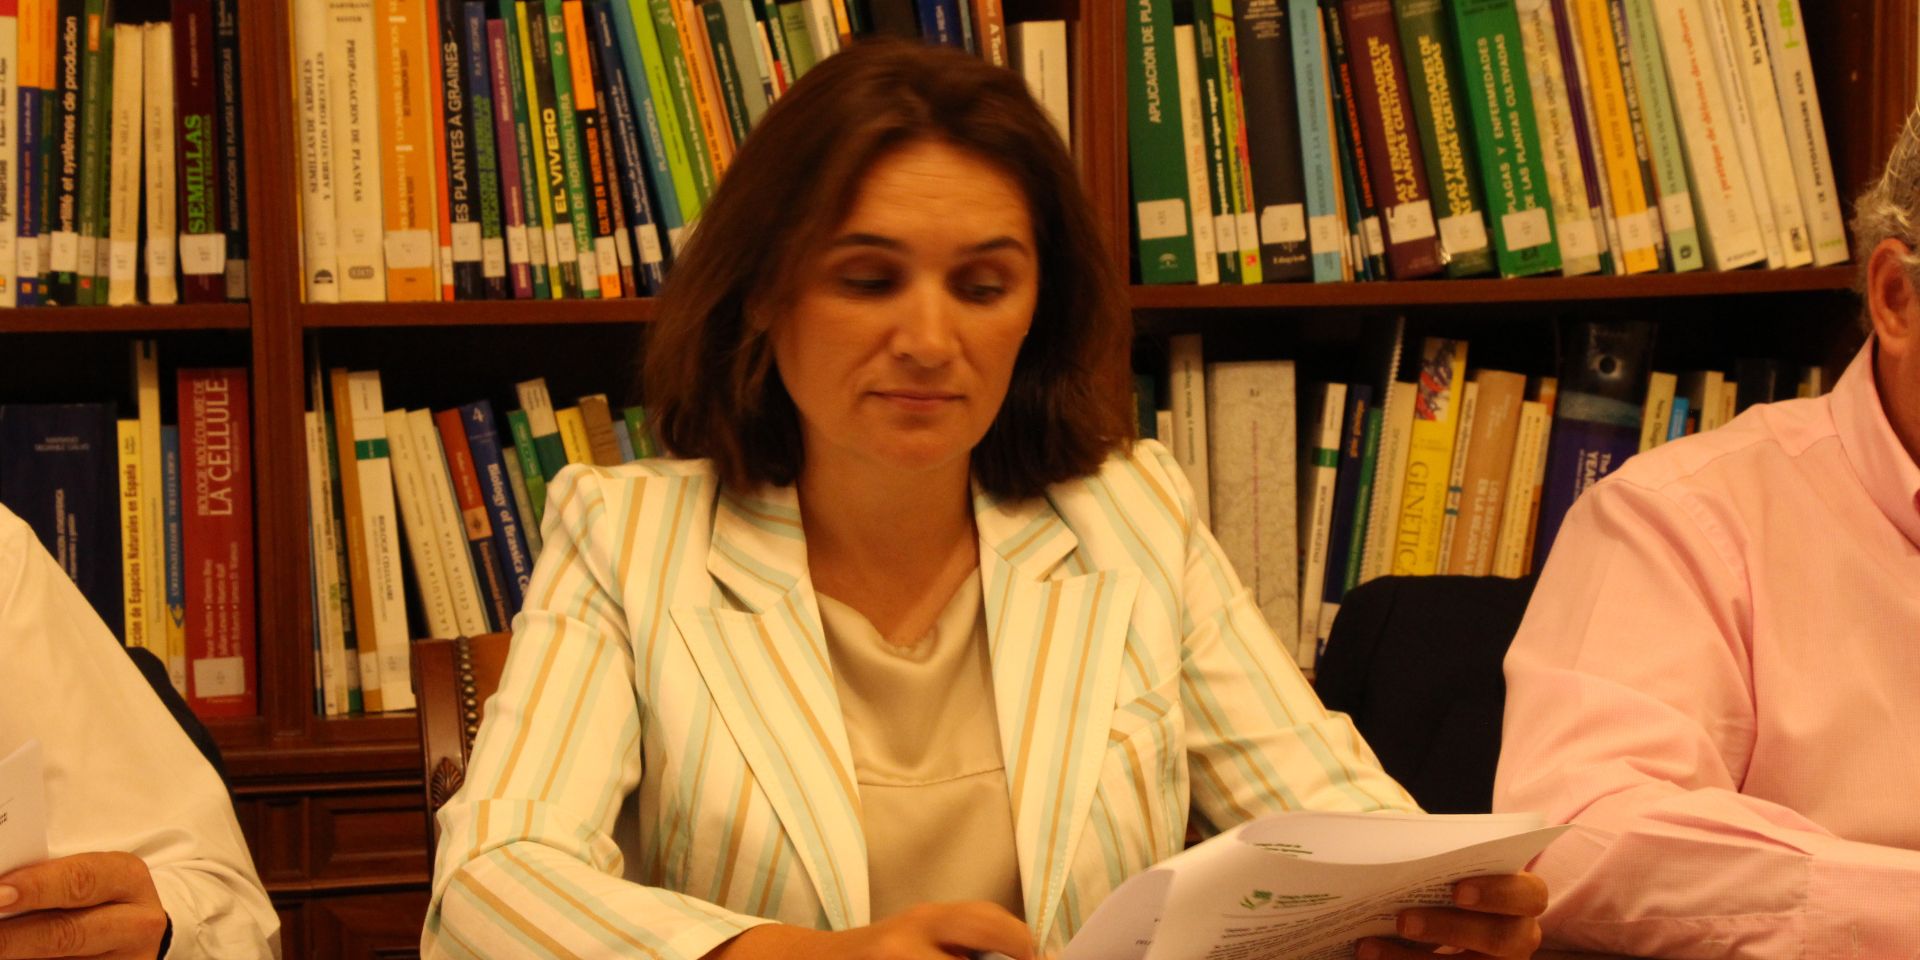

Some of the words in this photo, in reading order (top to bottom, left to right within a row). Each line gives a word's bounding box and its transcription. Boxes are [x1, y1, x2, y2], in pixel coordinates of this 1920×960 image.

[989, 23, 1000, 35] A
[1141, 25, 1154, 43] DE
[1367, 36, 1380, 57] DE
[1418, 35, 1431, 56] DE
[63, 16, 80, 90] production
[1495, 33, 1517, 107] CULTIVADAS
[345, 39, 359, 125] PROPAGACION
[445, 41, 461, 111] GRAINES
[1142, 46, 1161, 123] APLICACIÓN
[1380, 43, 1405, 130] CULTIVADAS
[1432, 41, 1455, 130] CULTIVADAS
[1477, 37, 1504, 138] ENFERMEDADES
[306, 118, 315, 133] DE
[1370, 58, 1402, 170] ENFERMEDADES
[1423, 56, 1452, 170] ENFERMEDADES
[1705, 127, 1716, 141] de
[350, 128, 360, 144] DE
[542, 107, 563, 187] VIVERO
[561, 92, 581, 188] HORTICULTURA
[1497, 146, 1507, 155] Y
[1509, 111, 1528, 164] PLANTAS
[184, 114, 207, 233] SEMILLAS
[306, 135, 318, 194] SEMILLAS
[351, 148, 363, 203] PLANTAS
[449, 129, 469, 201] PLANTES
[1396, 134, 1419, 199] PLANTAS
[1449, 132, 1470, 197] PLANTAS
[1519, 167, 1533, 190] LAS
[554, 188, 568, 213] EL
[573, 192, 584, 209] DE
[1445, 182, 1462, 217] AGAS
[1500, 162, 1517, 213] PLAGAS
[1525, 193, 1537, 209] DE
[455, 203, 470, 223] ES
[193, 380, 205, 394] DE
[193, 396, 208, 467] MOLÉCULAIRE
[206, 378, 232, 482] CELLULE
[124, 463, 140, 499] España
[486, 463, 509, 508] Biology
[1599, 453, 1612, 473] The
[127, 500, 138, 512] en
[196, 469, 209, 516] BIOLOGIE
[207, 487, 233, 515] LA
[125, 515, 141, 560] Naturales
[500, 510, 514, 522] of
[504, 524, 526, 573] Brassica
[127, 562, 144, 604] Espacios
[129, 607, 142, 618] de
[130, 620, 144, 646] cción
